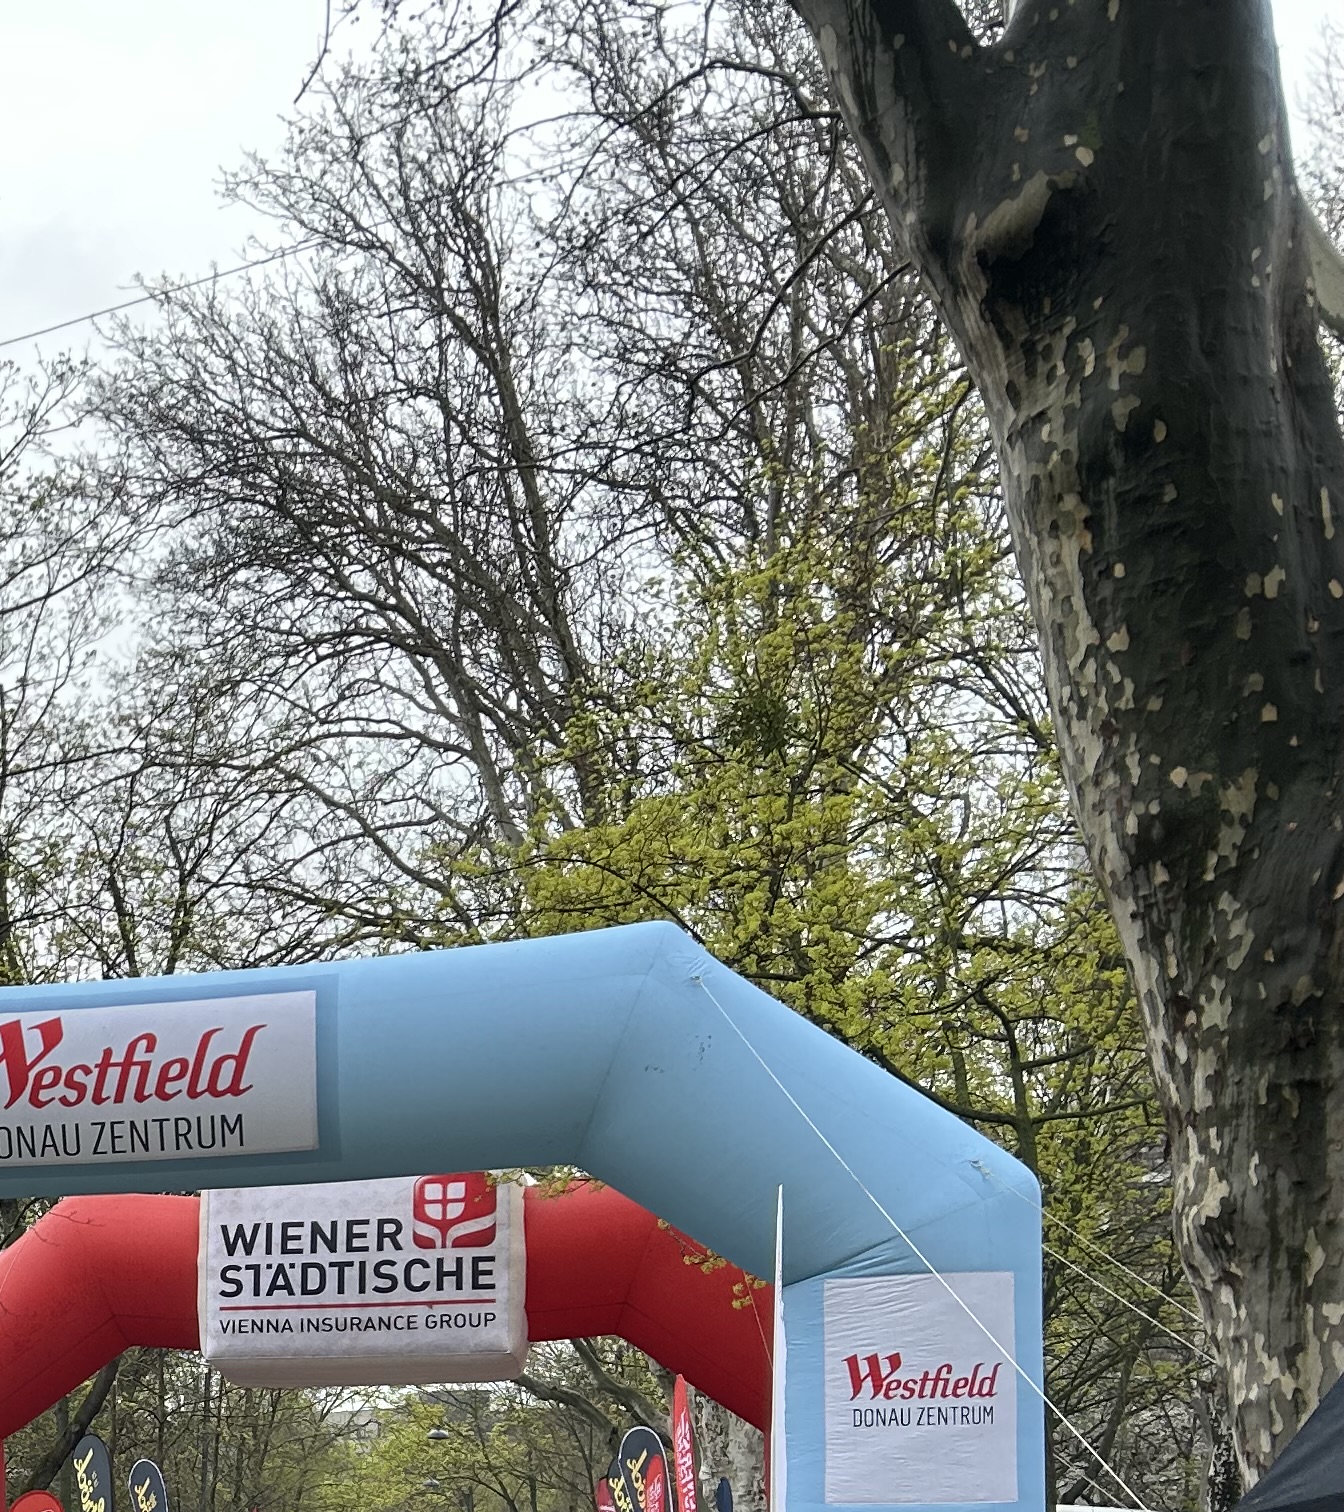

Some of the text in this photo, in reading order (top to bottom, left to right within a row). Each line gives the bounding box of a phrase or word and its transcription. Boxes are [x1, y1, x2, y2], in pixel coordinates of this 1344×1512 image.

[91, 1113, 245, 1155] ZENTRUM
[220, 1217, 404, 1257] WIENER
[218, 1255, 497, 1298] STÄDTISCHE
[219, 1312, 497, 1335] VIENNA INSURANCE GROUP
[841, 1352, 1003, 1401] Westfield
[853, 1405, 995, 1428] DONAU ZENTRUM
